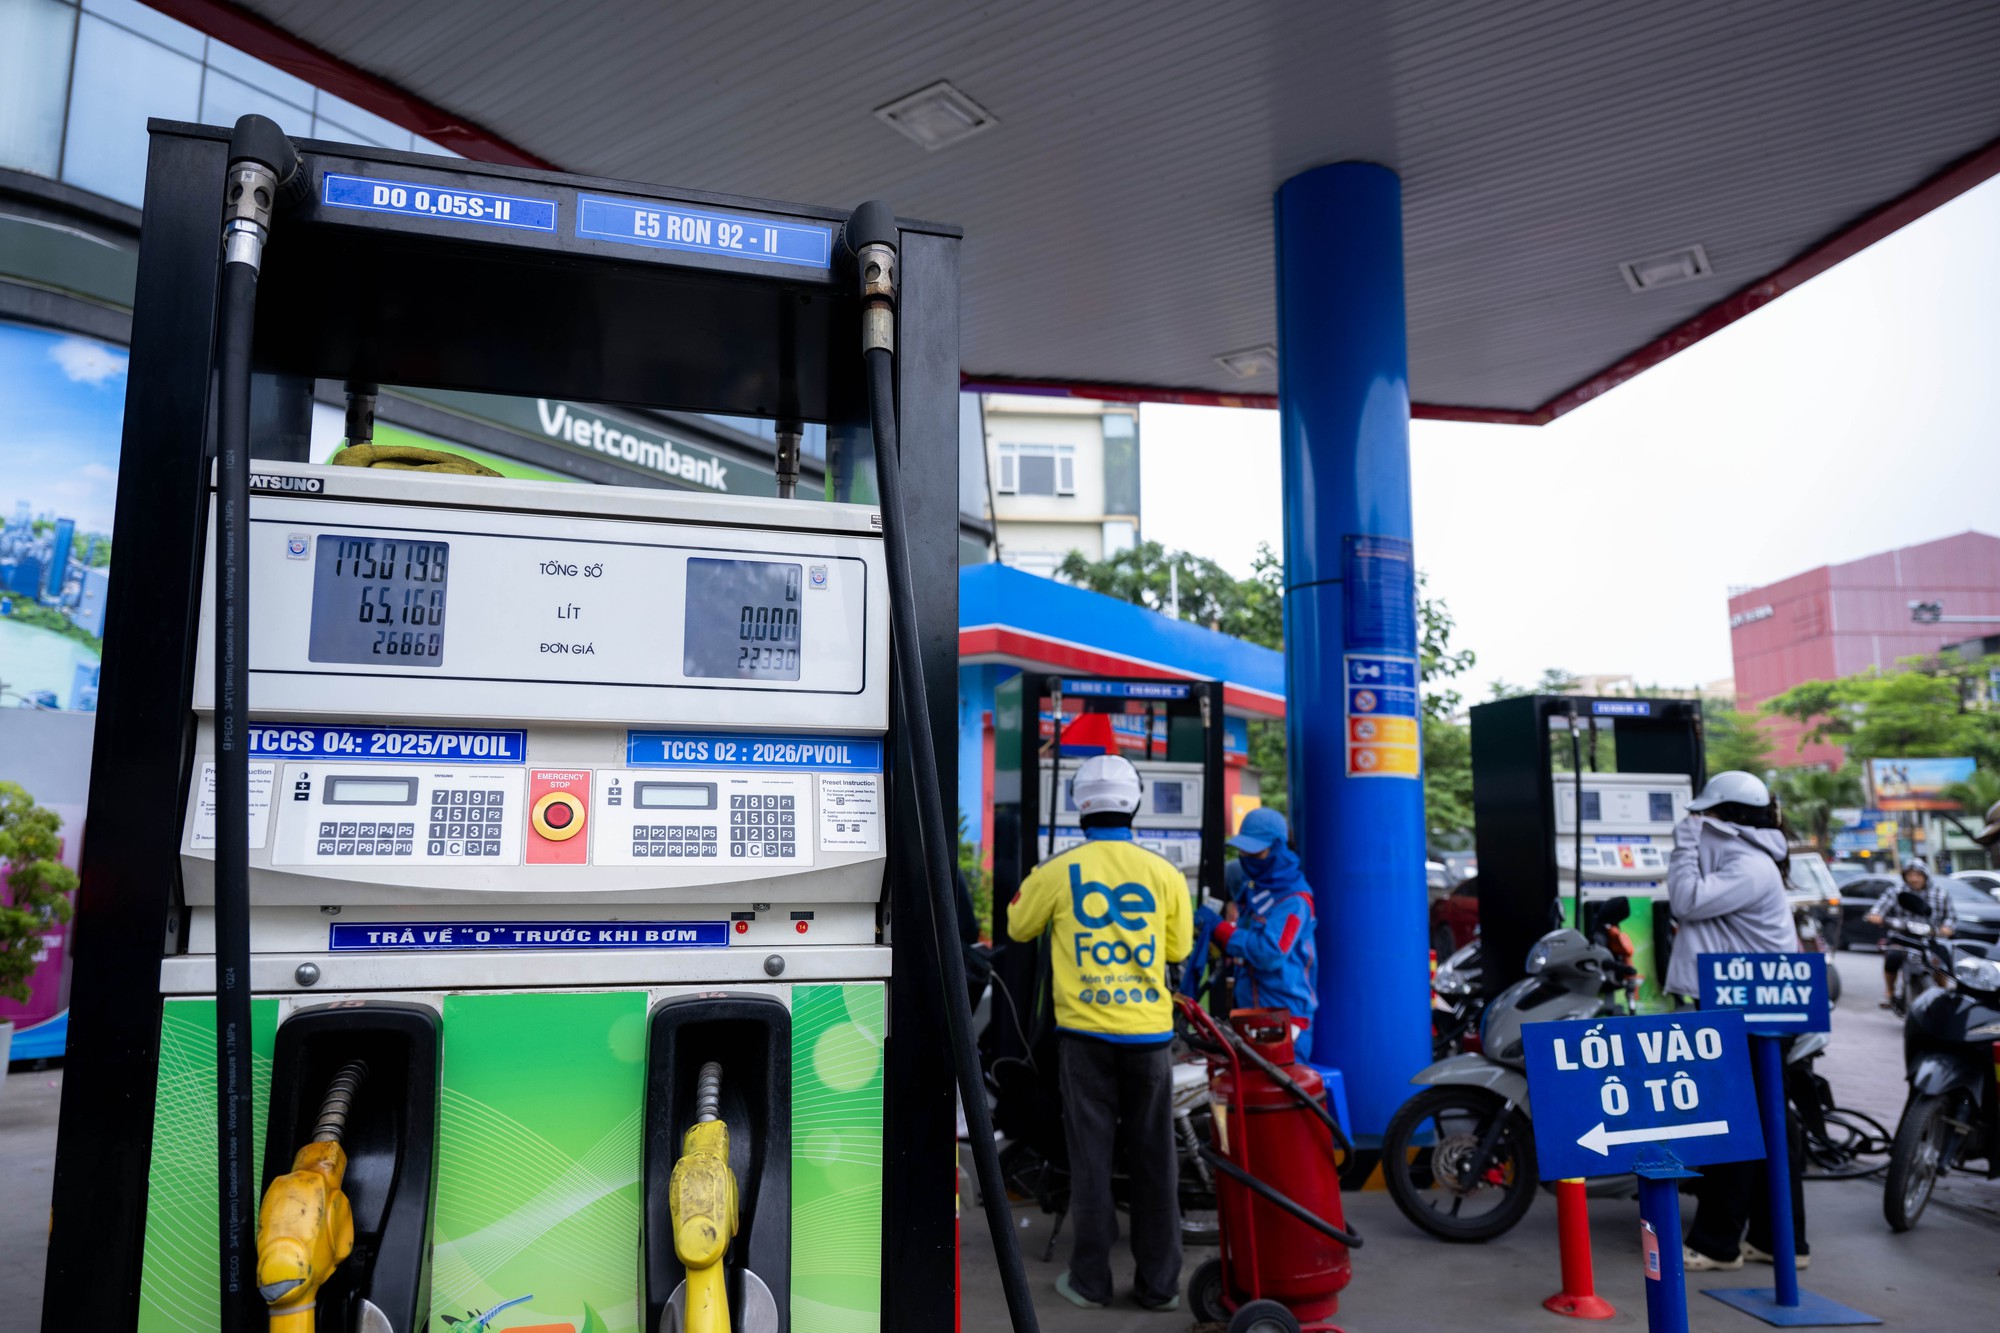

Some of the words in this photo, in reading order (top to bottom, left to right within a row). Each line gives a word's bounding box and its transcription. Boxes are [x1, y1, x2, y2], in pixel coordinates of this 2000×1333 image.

[374, 186, 406, 207] DO
[415, 192, 510, 220] 0,05S-II
[634, 211, 660, 238] E5
[667, 216, 710, 245] RON
[718, 223, 743, 249] 92
[765, 229, 777, 253] II
[537, 399, 728, 491] Vietcombank
[250, 475, 320, 491] ATSUNO
[226, 500, 234, 529] 1.7MPa
[226, 531, 234, 565] Pressure
[540, 561, 578, 576] TỔNG
[584, 563, 603, 577] SỐ
[225, 567, 235, 599] Working
[786, 568, 798, 601] 0
[225, 606, 234, 626] Hose
[359, 586, 444, 627] 65,160
[558, 603, 580, 619] LÍT
[740, 606, 798, 643] 0,000
[225, 628, 234, 663] Gasoline
[373, 631, 440, 656] 26860
[540, 643, 568, 653] ĐƠN
[572, 642, 594, 654] GIÁ
[738, 647, 796, 670] 22330
[224, 716, 233, 742] PECO
[249, 730, 314, 752] TCCS
[323, 732, 362, 753] 04:
[371, 733, 511, 756] 2025/PVOIL
[662, 741, 708, 760] TCCS
[714, 742, 736, 761] 02
[753, 743, 851, 764] 2026/PVOIL
[437, 792, 445, 802] 7
[455, 792, 463, 803] 8
[473, 793, 481, 803] 9
[734, 797, 742, 807] 7
[751, 797, 758, 807] 8
[767, 798, 774, 807] 9
[435, 809, 443, 819] 4
[453, 810, 461, 820] 5
[472, 810, 480, 820] 6
[734, 813, 742, 823] 4
[751, 813, 758, 823] 5
[767, 813, 774, 823] 6
[322, 826, 334, 834] P1
[341, 826, 355, 834] P2
[360, 826, 374, 835] P3
[399, 826, 412, 835] P5
[434, 826, 440, 836] 1
[452, 826, 460, 836] 2
[470, 826, 479, 837] 3
[635, 829, 646, 837] P1
[652, 829, 664, 837] P2
[670, 829, 681, 837] P3
[687, 829, 698, 837] P4
[735, 829, 740, 839] 1
[751, 829, 758, 839] 2
[768, 829, 774, 839] 3
[320, 843, 333, 852] P6
[339, 844, 353, 852] P7
[358, 844, 372, 852] P8
[378, 844, 391, 852] P9
[396, 844, 411, 852] P10
[432, 843, 440, 853] 0
[450, 843, 460, 853] C
[634, 845, 647, 853] P6
[734, 845, 742, 855] 0
[750, 845, 759, 855] C
[1069, 863, 1156, 931] be
[367, 928, 415, 943] TRẢ
[423, 928, 452, 943] VỀ
[513, 929, 591, 942] TRƯỚC
[599, 931, 637, 941] KHI
[645, 929, 697, 941] BƠM
[1074, 932, 1155, 968] Food
[1713, 957, 1753, 980] LỐI
[1760, 955, 1811, 980] VÀO
[1715, 986, 1748, 1005] XE
[1756, 982, 1812, 1005] MÁY
[1553, 1023, 1625, 1070] LỐI
[1637, 1023, 1723, 1064] VÀO
[228, 1057, 237, 1094] Pressure
[1600, 1075, 1629, 1116] Ô
[1644, 1071, 1699, 1112] TÔ
[228, 1095, 239, 1129] Working
[229, 1136, 238, 1159] Hose
[229, 1161, 238, 1197] Gasoline
[230, 1256, 239, 1282] PECO
